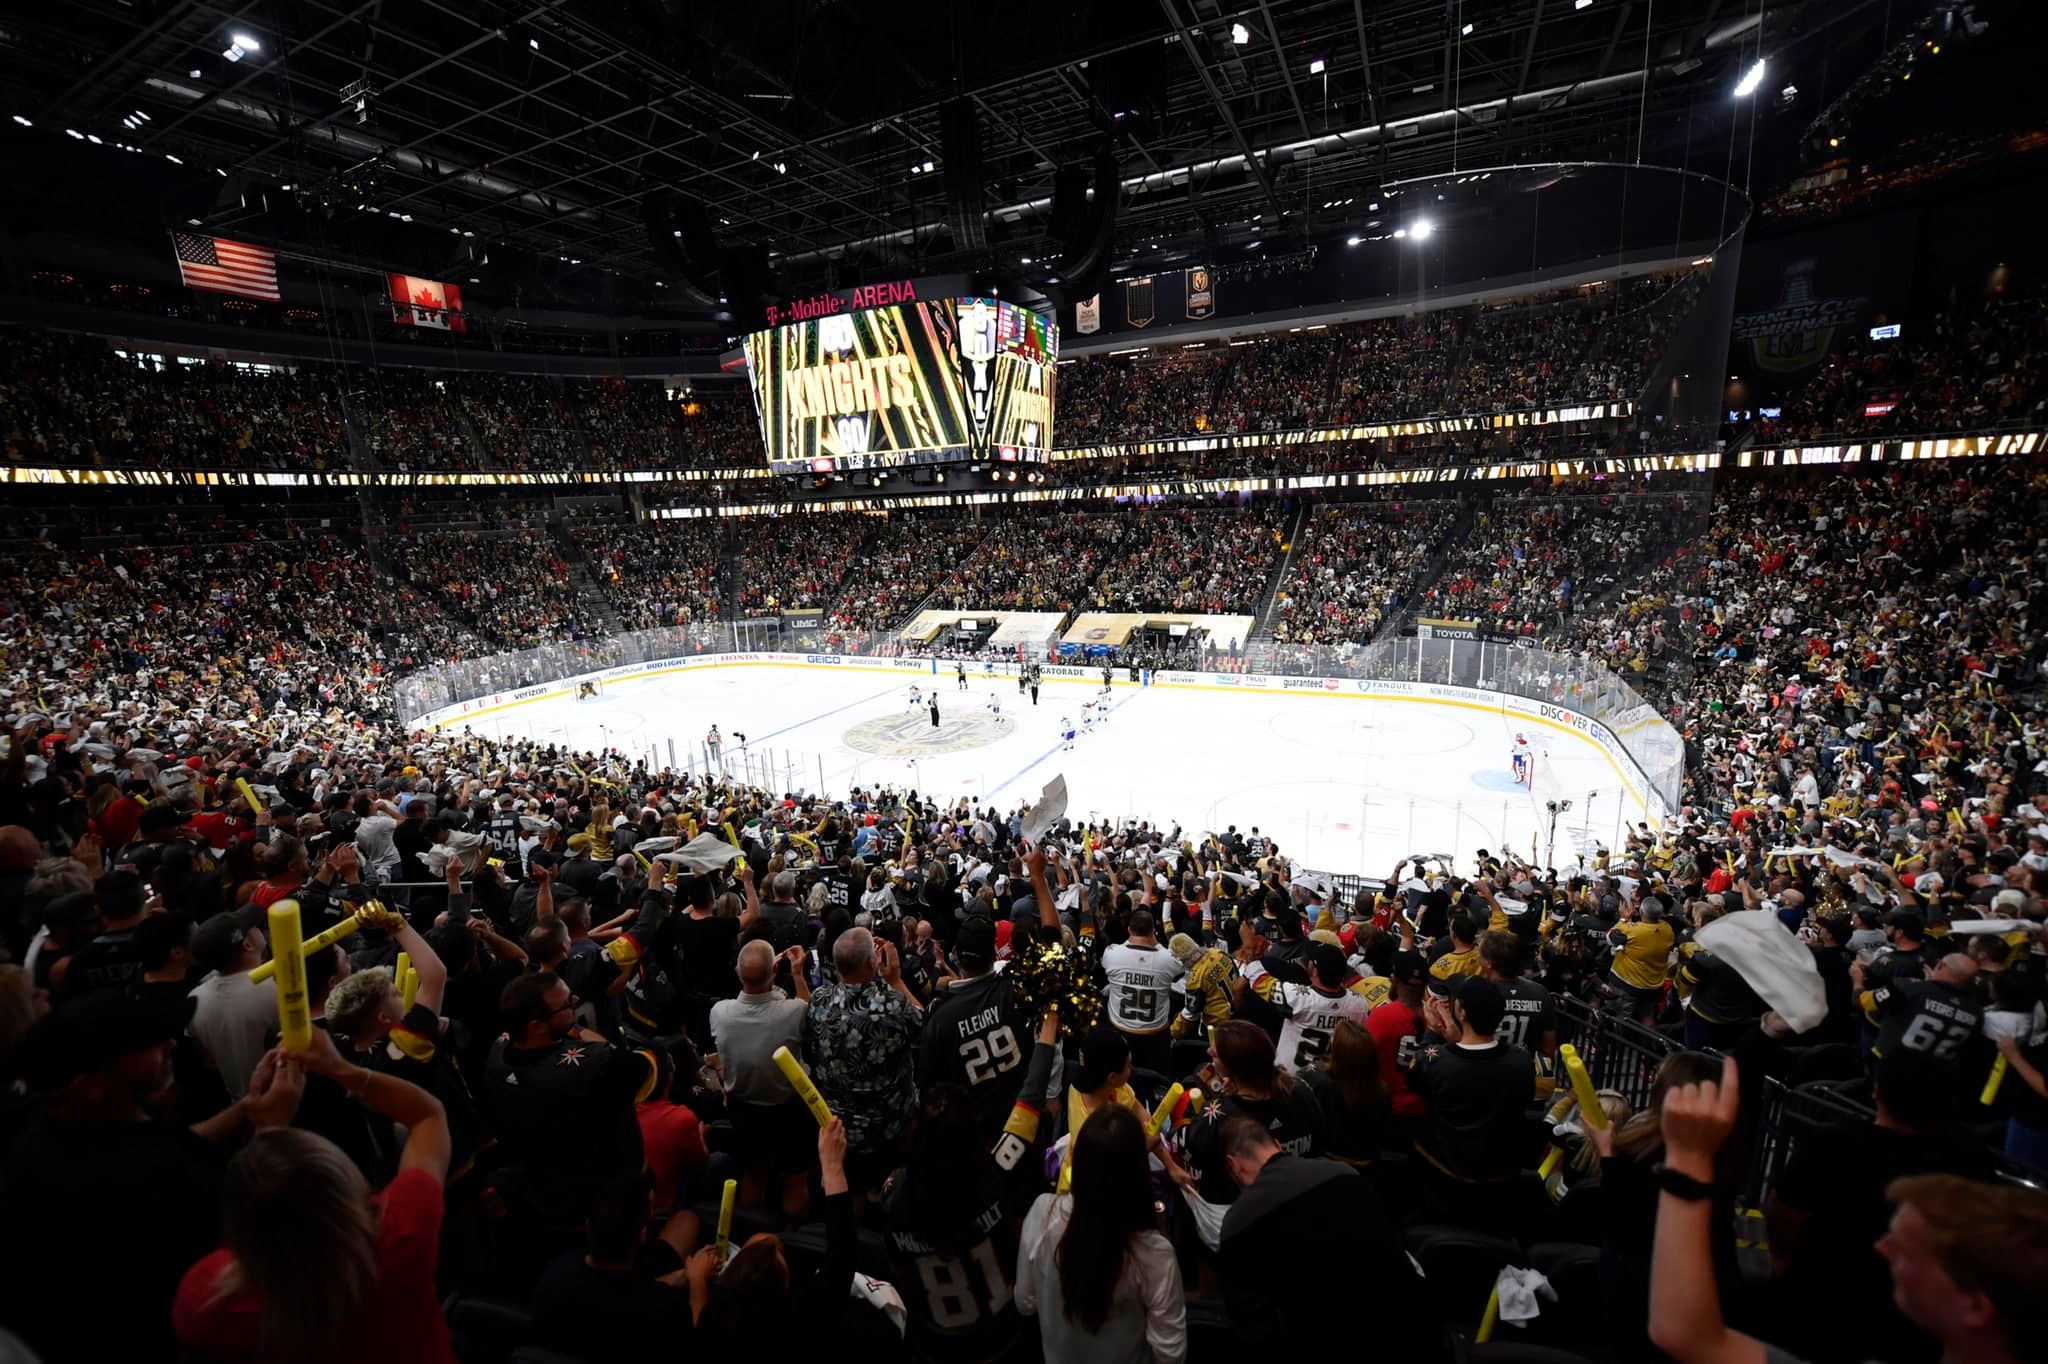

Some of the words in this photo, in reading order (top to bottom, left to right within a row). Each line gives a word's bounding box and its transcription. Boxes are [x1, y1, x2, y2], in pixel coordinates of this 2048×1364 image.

[853, 280, 918, 310] ARENA
[783, 351, 914, 419] KNIGHTS
[837, 416, 867, 452] GO
[1435, 629, 1475, 640] TOYOTA
[663, 658, 687, 669] LIGHT
[720, 653, 760, 662] HONDA
[807, 655, 841, 664] GEICO
[893, 658, 922, 669] betway
[1039, 667, 1085, 677] GATORADE
[513, 687, 548, 700] verizon
[1283, 678, 1323, 690] guaranteed
[1540, 704, 1588, 731] DISCOVER
[491, 829, 517, 852] 64
[830, 887, 850, 907] 29
[1124, 972, 1155, 987] FLEURY
[1119, 985, 1157, 1022] 29
[1925, 998, 1954, 1019] VEGAS
[957, 1004, 1001, 1039] FLEURY
[958, 1023, 1023, 1087] 29
[914, 1233, 1013, 1331] 81
